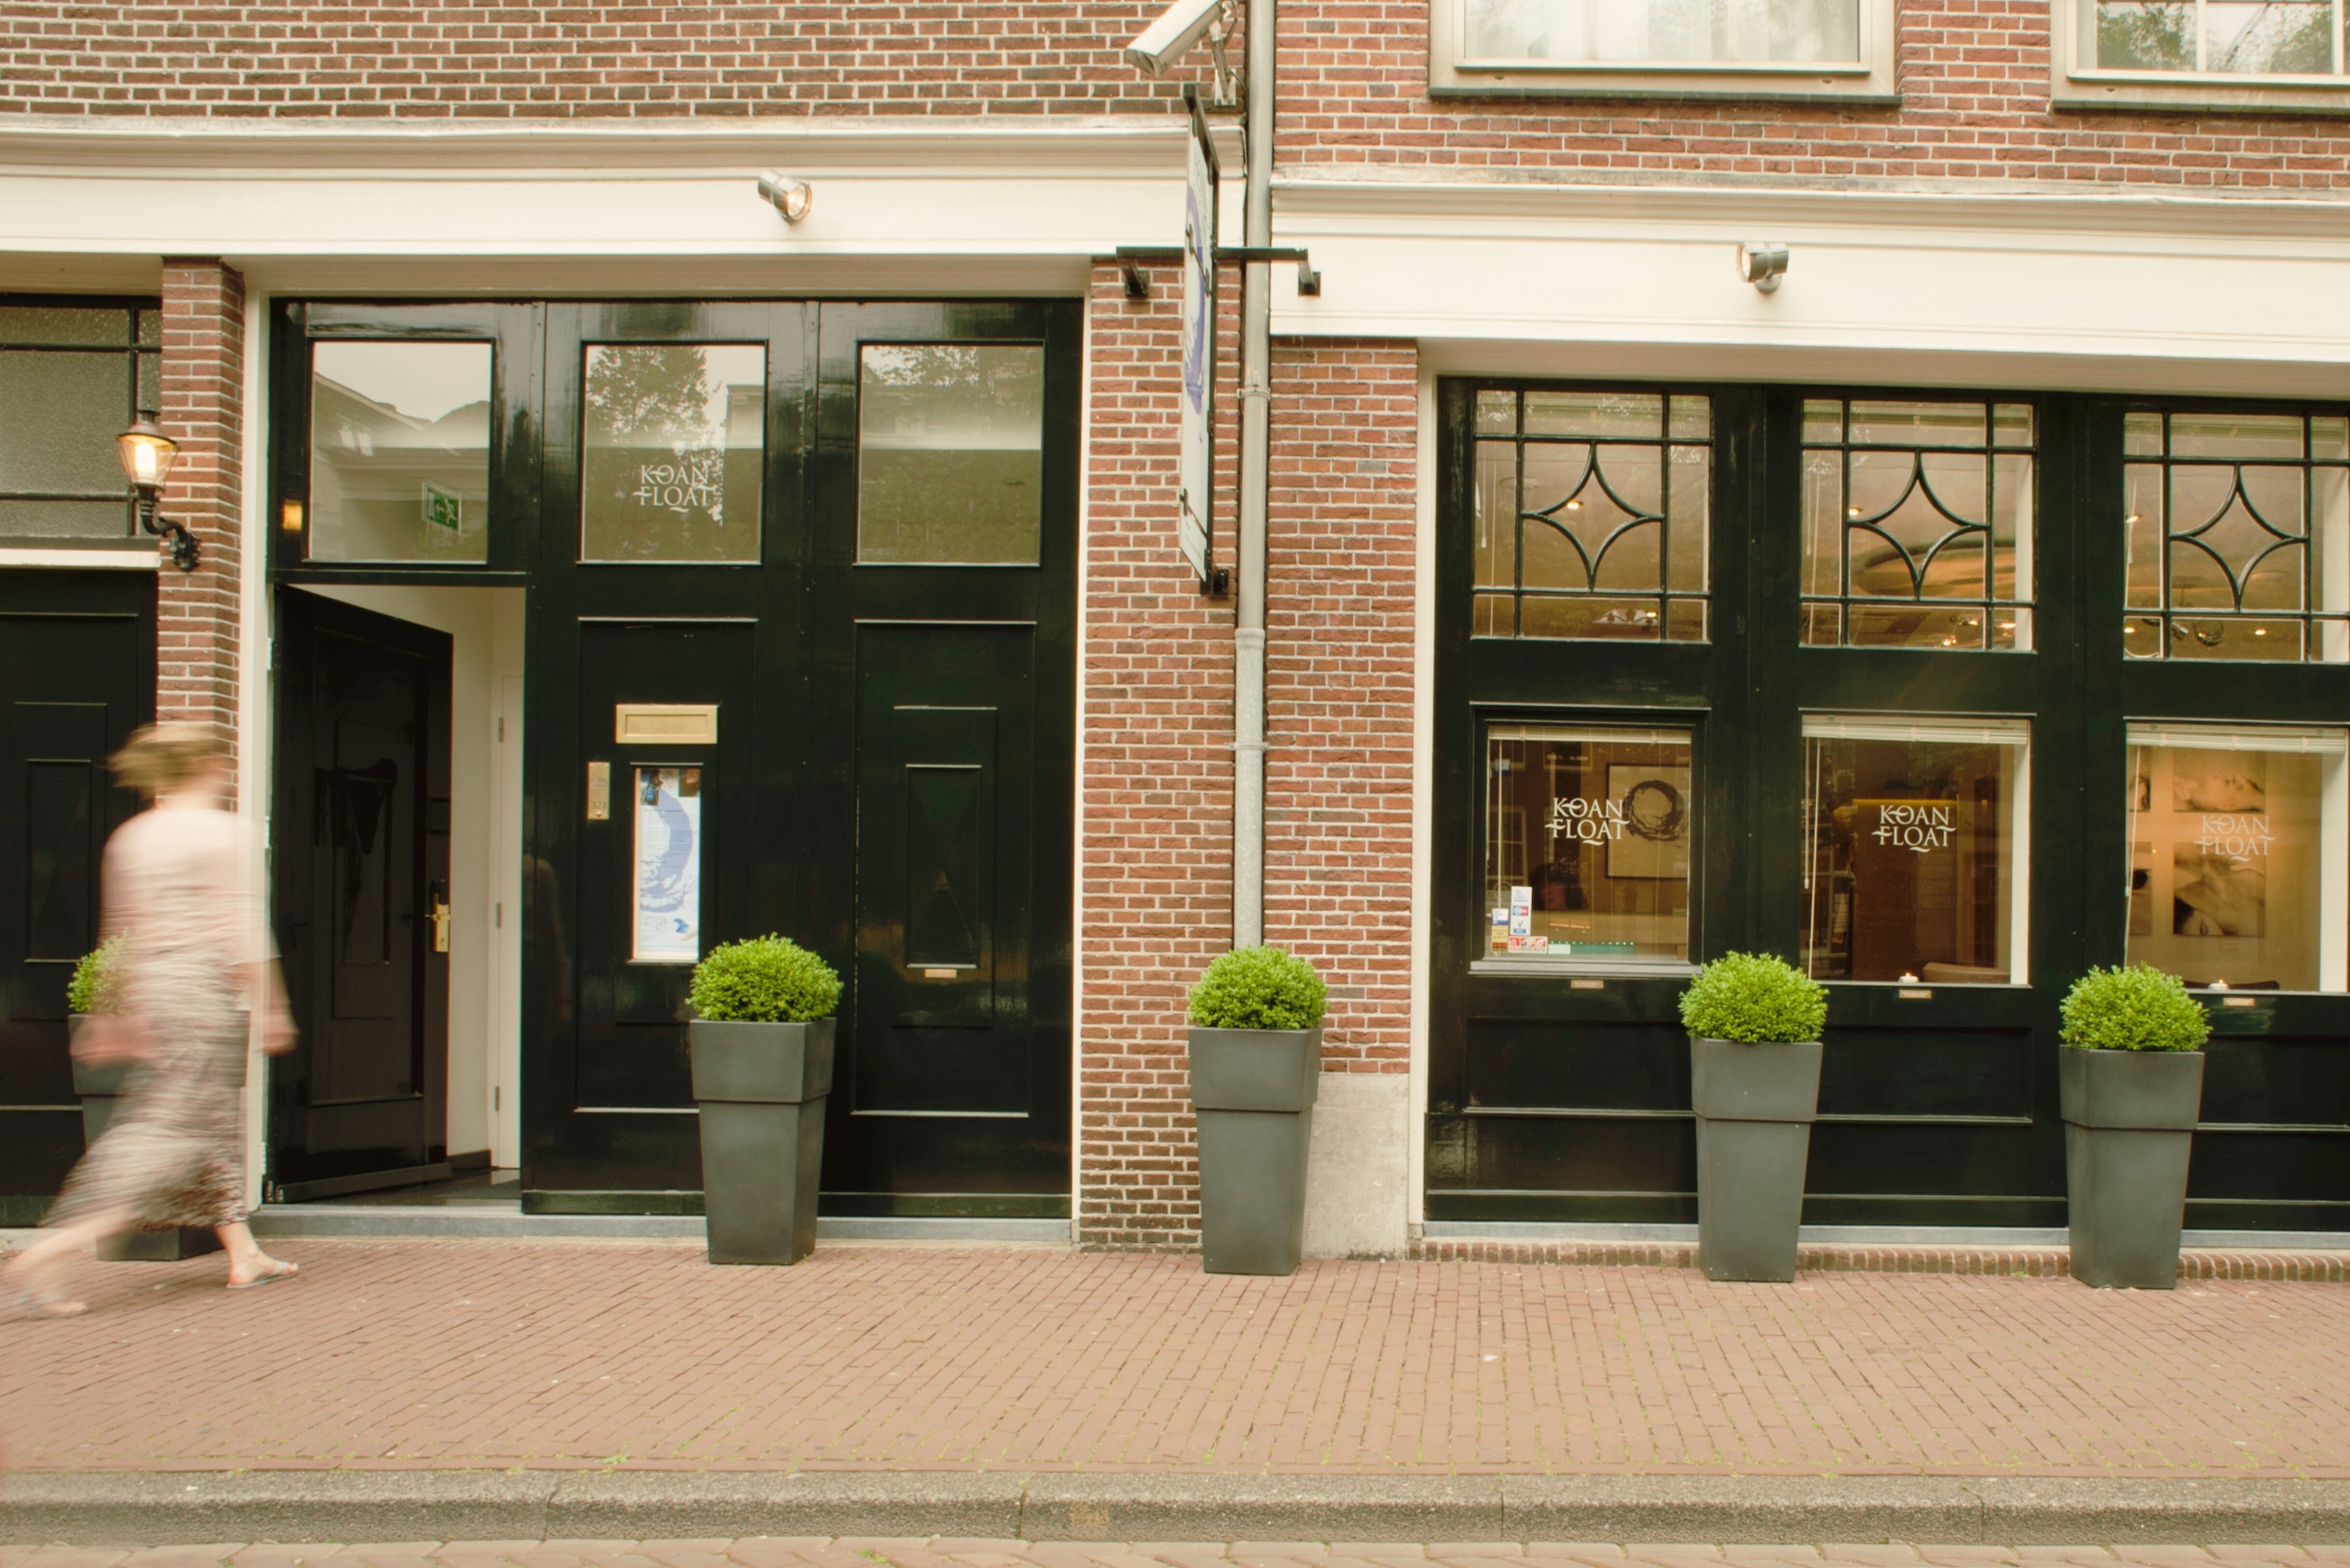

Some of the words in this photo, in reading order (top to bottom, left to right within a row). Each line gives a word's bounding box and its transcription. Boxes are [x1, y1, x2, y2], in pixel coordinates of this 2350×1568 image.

[641, 465, 710, 485] KOAN
[632, 485, 718, 512] FLOAT
[591, 801, 607, 810] 321
[1552, 797, 1623, 818] KOAN
[1879, 805, 1950, 825] KOAN
[1544, 818, 1630, 846] FLOAT
[2201, 814, 2270, 834] KOAN
[1871, 825, 1957, 853] FLOAT
[2194, 834, 2277, 862] FLOAT
